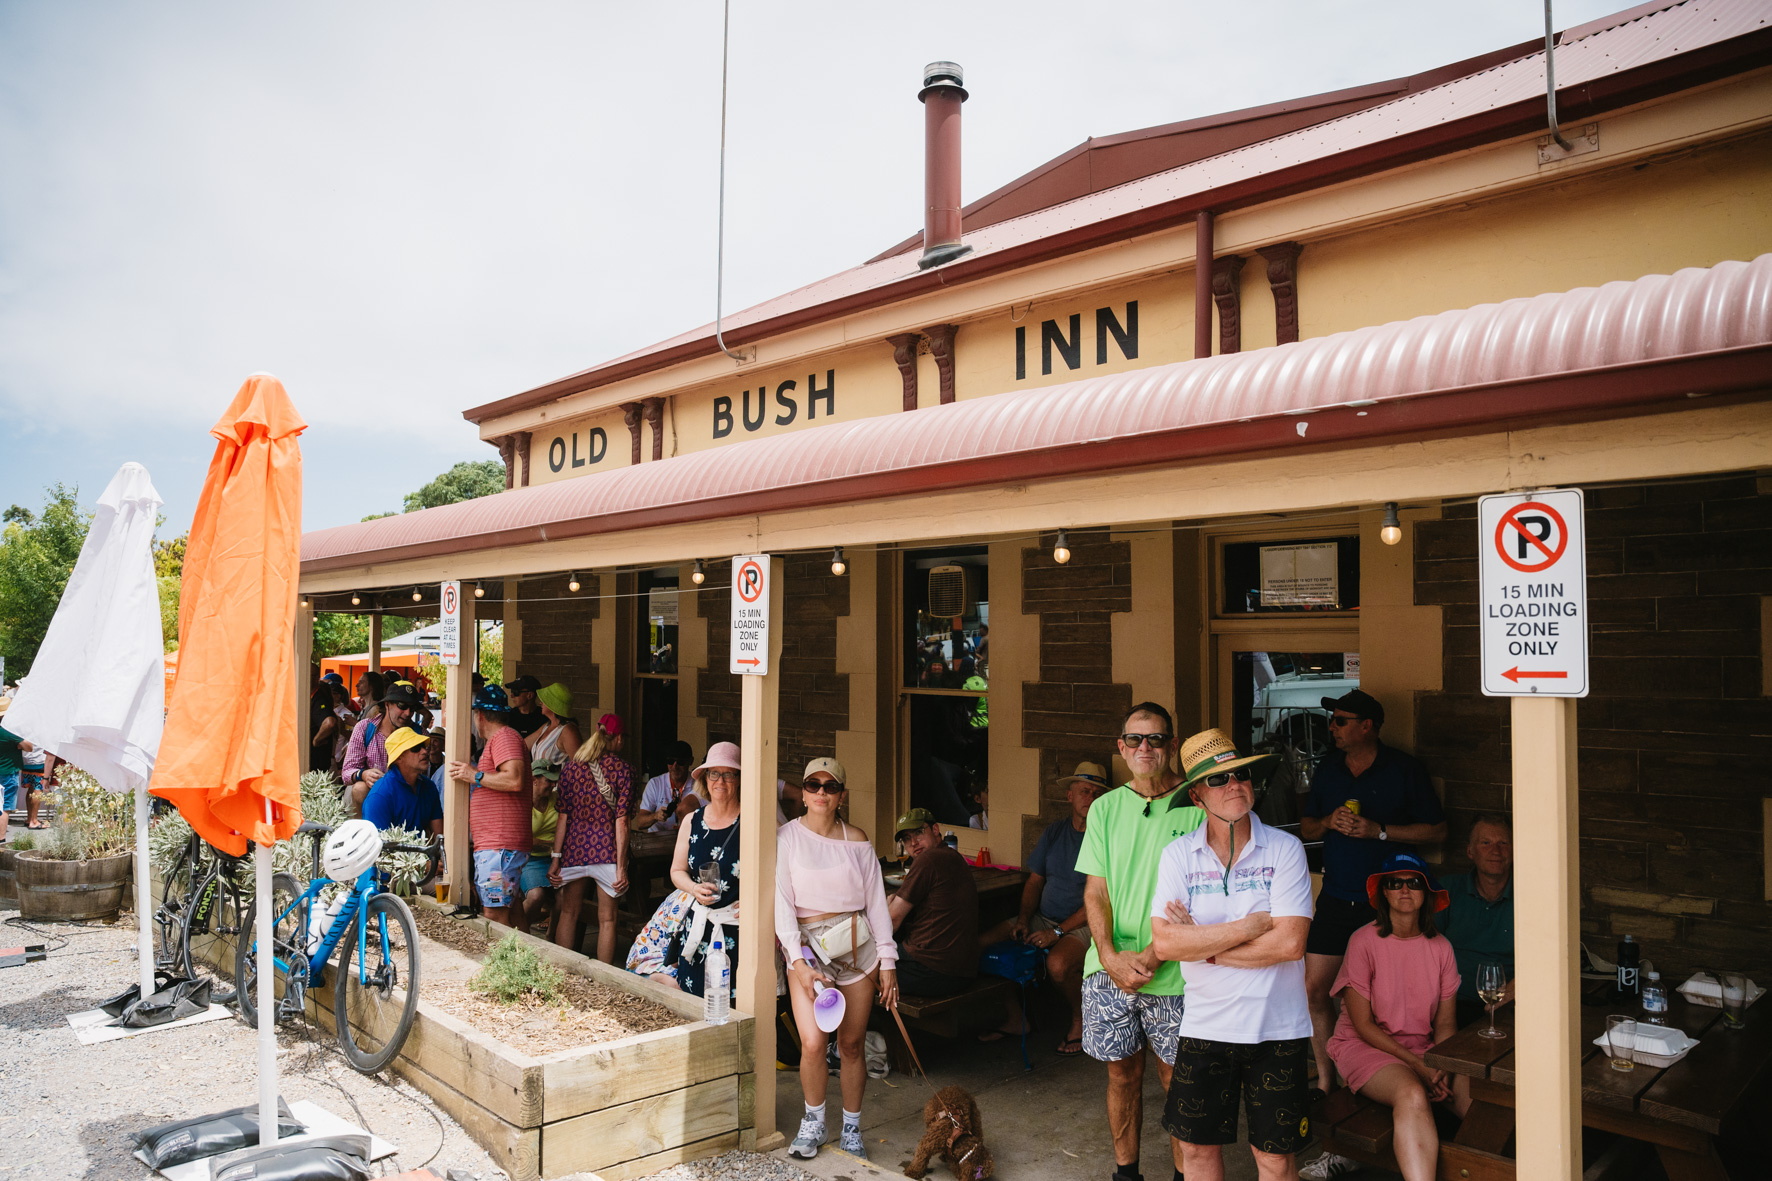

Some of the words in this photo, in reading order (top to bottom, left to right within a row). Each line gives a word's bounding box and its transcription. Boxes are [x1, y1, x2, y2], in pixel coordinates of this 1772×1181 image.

[549, 427, 607, 473] OLD
[713, 369, 835, 439] BUSH
[1015, 300, 1138, 380] INN
[1501, 585, 1521, 599] 15
[1527, 583, 1564, 598] MIN
[738, 609, 746, 618] 15
[747, 608, 761, 617] MIN
[1489, 602, 1577, 618] LOADING
[734, 620, 765, 629] LOADING
[1505, 621, 1560, 637] ZONE
[739, 631, 759, 640] ZONE
[740, 642, 758, 651] ONLY
[1508, 641, 1558, 656] ONLY
